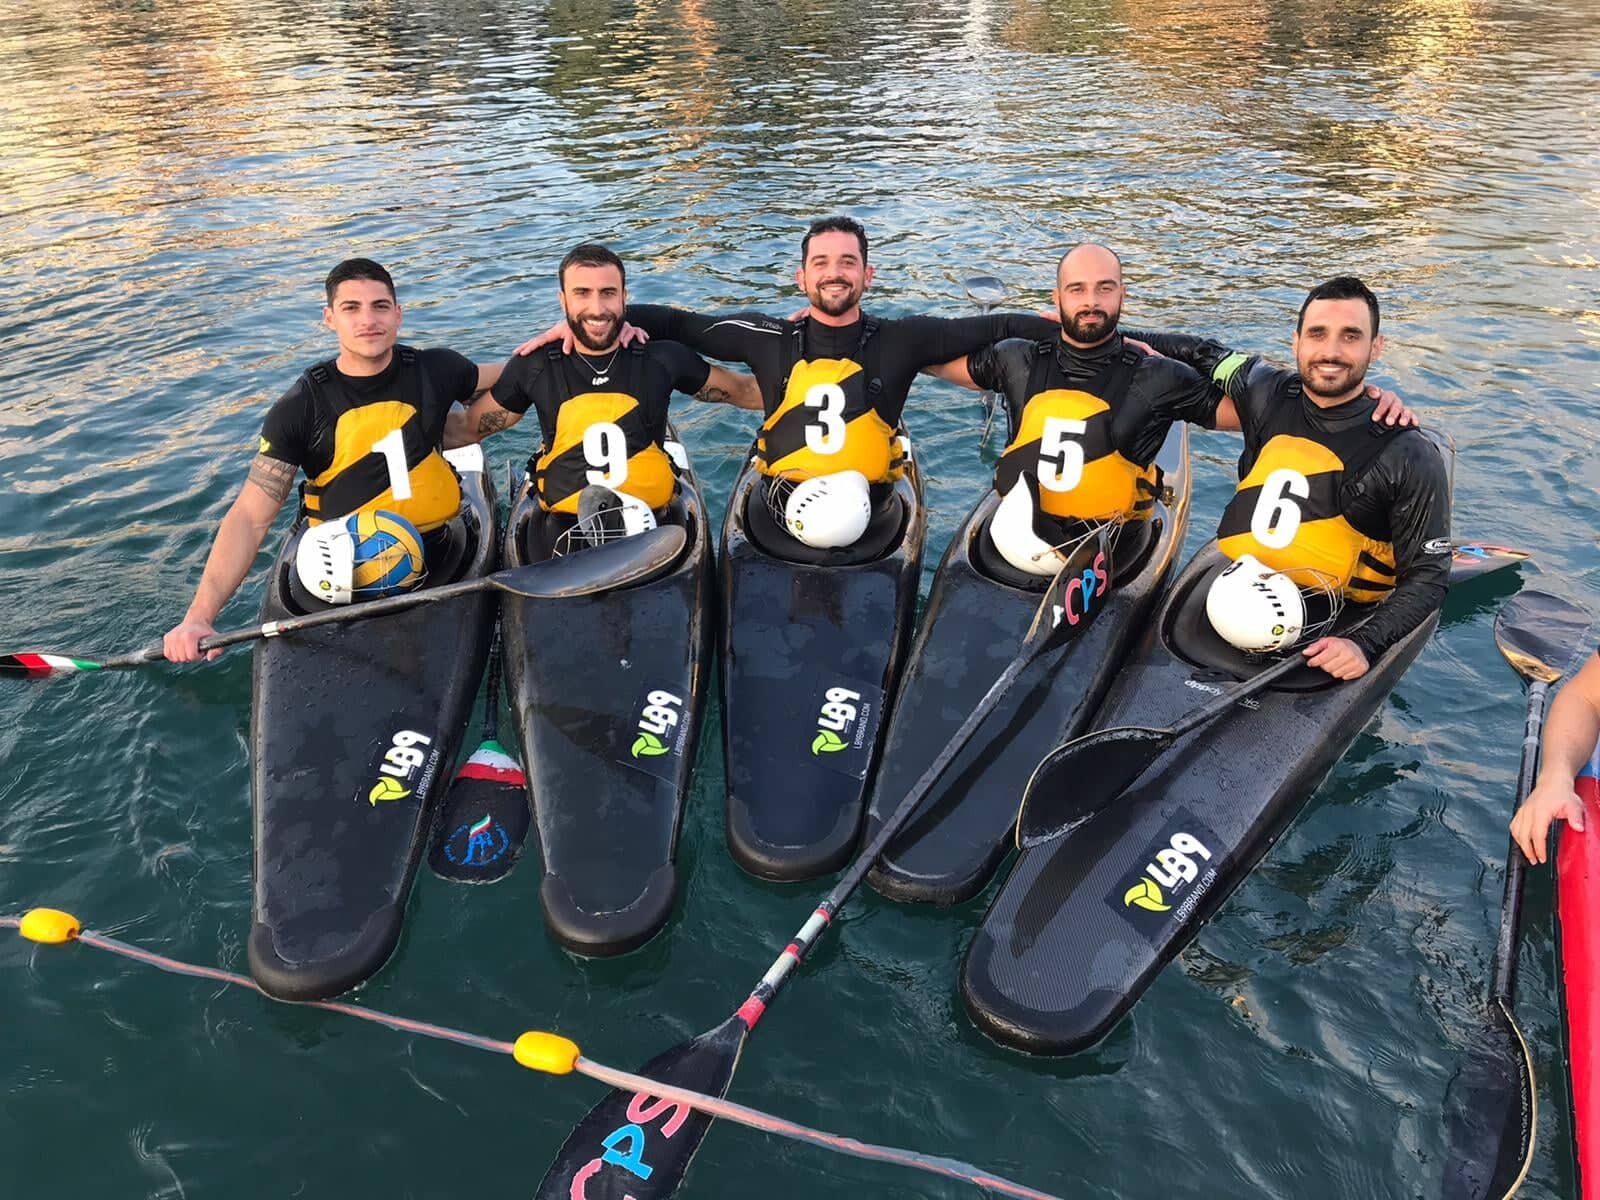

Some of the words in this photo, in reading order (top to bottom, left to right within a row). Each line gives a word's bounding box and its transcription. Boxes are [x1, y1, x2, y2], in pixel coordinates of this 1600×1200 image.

[804, 383, 847, 455] 3
[371, 428, 412, 501] 1
[582, 422, 628, 489] 9
[1037, 416, 1087, 492] 5
[1251, 468, 1310, 549] 6
[1065, 551, 1107, 625] CPS
[638, 690, 683, 735] LB9
[817, 687, 861, 731] LB9
[379, 730, 432, 777] LB9
[1145, 832, 1212, 888] LB9
[1173, 867, 1218, 922] LB9BRAND.COM
